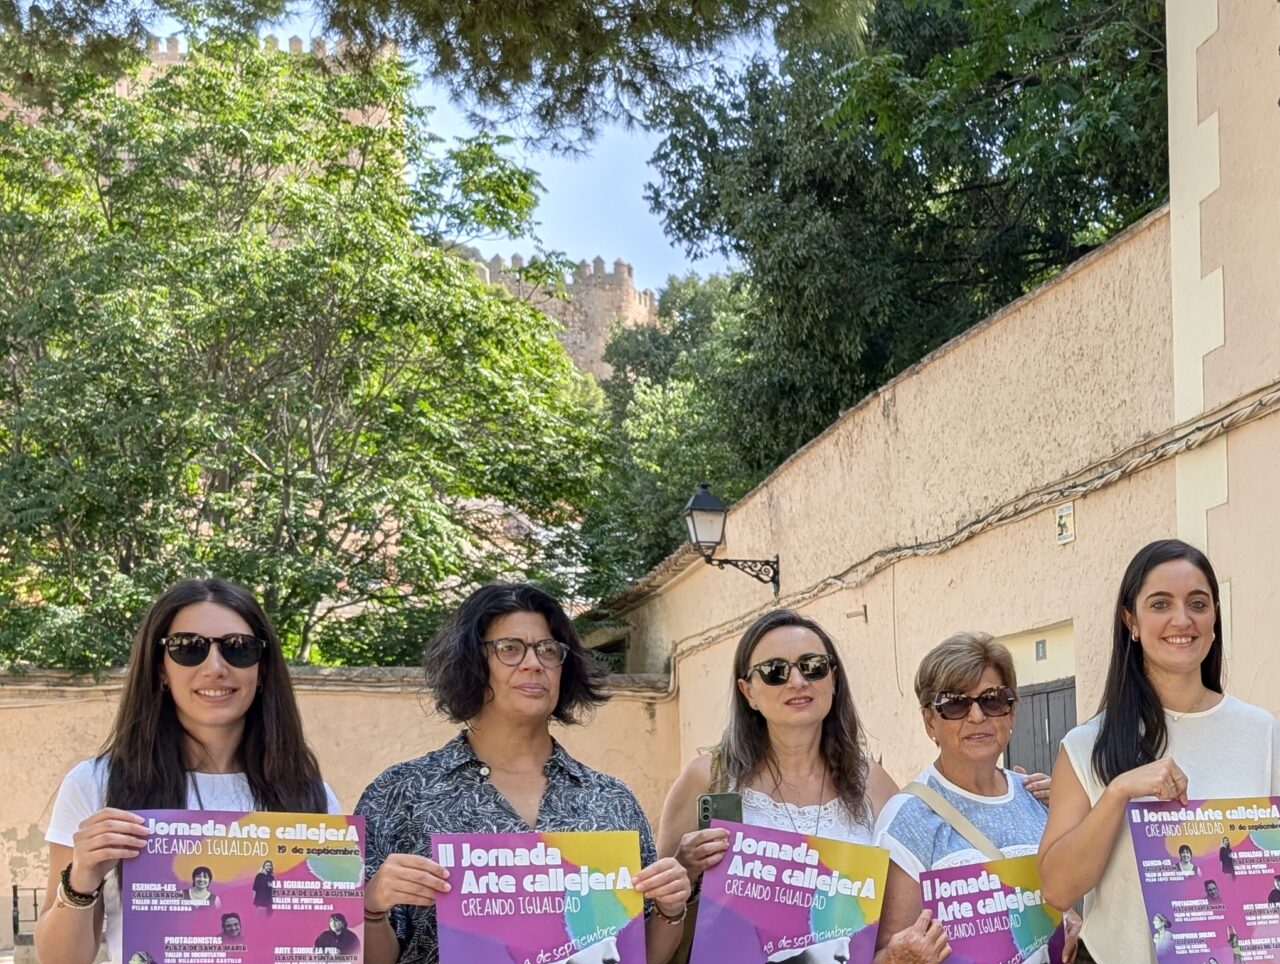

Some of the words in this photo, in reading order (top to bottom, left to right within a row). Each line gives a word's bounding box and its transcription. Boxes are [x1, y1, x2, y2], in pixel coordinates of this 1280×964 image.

[1131, 809, 1141, 823] II
[1143, 808, 1195, 822] Jornada
[1196, 807, 1223, 821] Arte
[1226, 804, 1280, 822] callejerA
[148, 818, 226, 836] Jornada
[228, 821, 270, 838] Arte
[276, 823, 359, 844] callejerA
[1145, 823, 1182, 837] CREANDO
[1183, 822, 1224, 836] IGUALDAD
[147, 838, 202, 855] CREANDO
[206, 839, 269, 856] IGUALDAD
[277, 845, 287, 854] 19
[292, 845, 304, 854] de
[306, 846, 360, 856] septiembre
[438, 844, 455, 868] II
[462, 842, 562, 867] Jornada
[732, 832, 819, 866] Jornada
[272, 880, 282, 888] LA
[284, 880, 320, 889] IGUALDAD
[322, 881, 332, 890] SE
[333, 881, 356, 890] PINTA
[460, 870, 516, 894] Arte
[523, 866, 634, 896] callejerA
[727, 855, 775, 882] Arte
[782, 867, 875, 899] callejerA
[923, 880, 932, 901] II
[935, 871, 1001, 899] Jornada
[462, 897, 515, 916] CREANDO
[519, 896, 581, 914] IGUALDAD
[725, 879, 771, 901] CREANDO
[775, 887, 826, 910] IGUALDAD
[937, 901, 974, 922] Arte
[977, 886, 1043, 915] callejer
[164, 936, 222, 944] PROTAGONISTAS
[764, 941, 774, 954] 19
[778, 936, 791, 948] de
[794, 925, 852, 947] septiembre
[942, 922, 976, 940] REANDO
[976, 914, 1021, 935] IGUALDAD
[536, 949, 551, 964] de
[553, 926, 617, 960] septiembre
